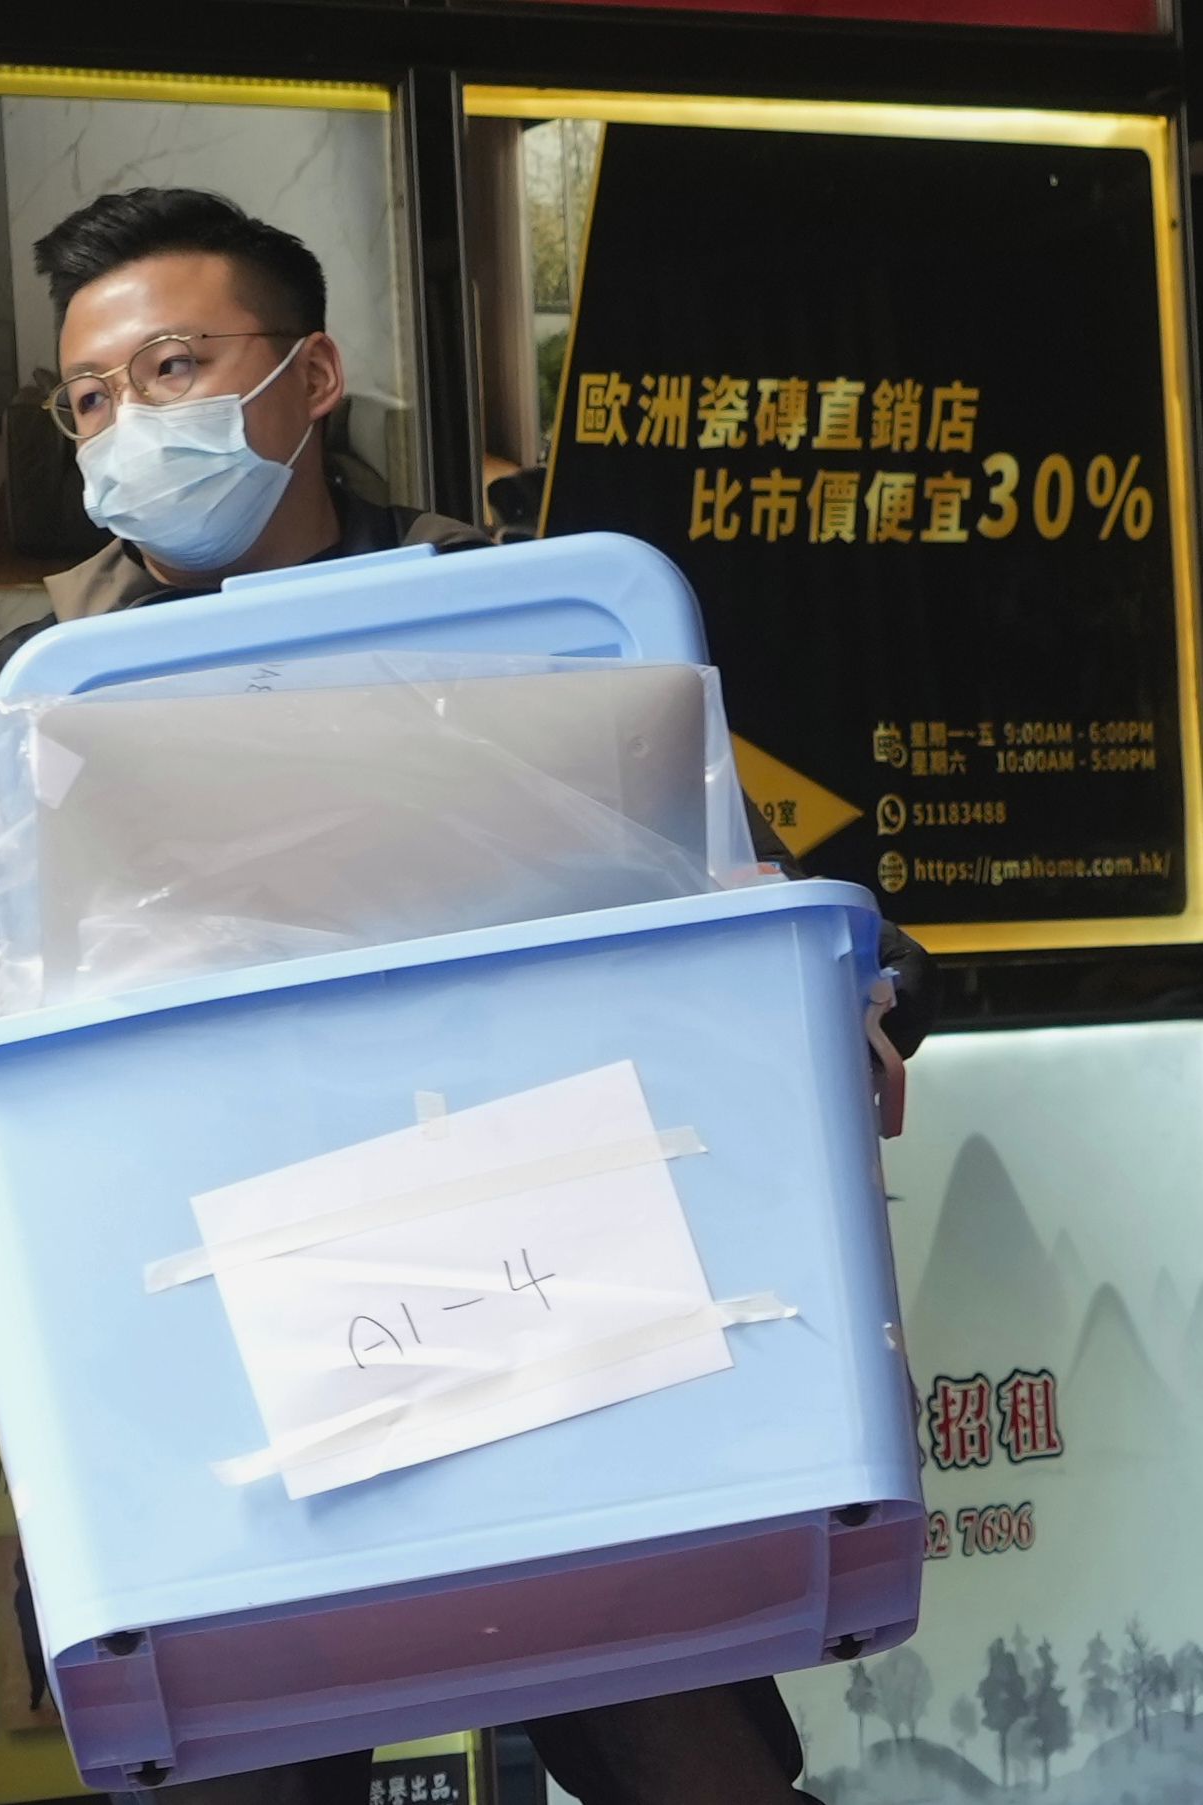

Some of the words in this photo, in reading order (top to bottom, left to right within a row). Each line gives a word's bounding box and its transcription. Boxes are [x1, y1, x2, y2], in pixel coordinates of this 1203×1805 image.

[575, 372, 980, 452] 歐洲瓷磚直銷店
[928, 1369, 1063, 1471] 招租
[923, 1511, 950, 1560] 2
[957, 1502, 1035, 1556] 7696
